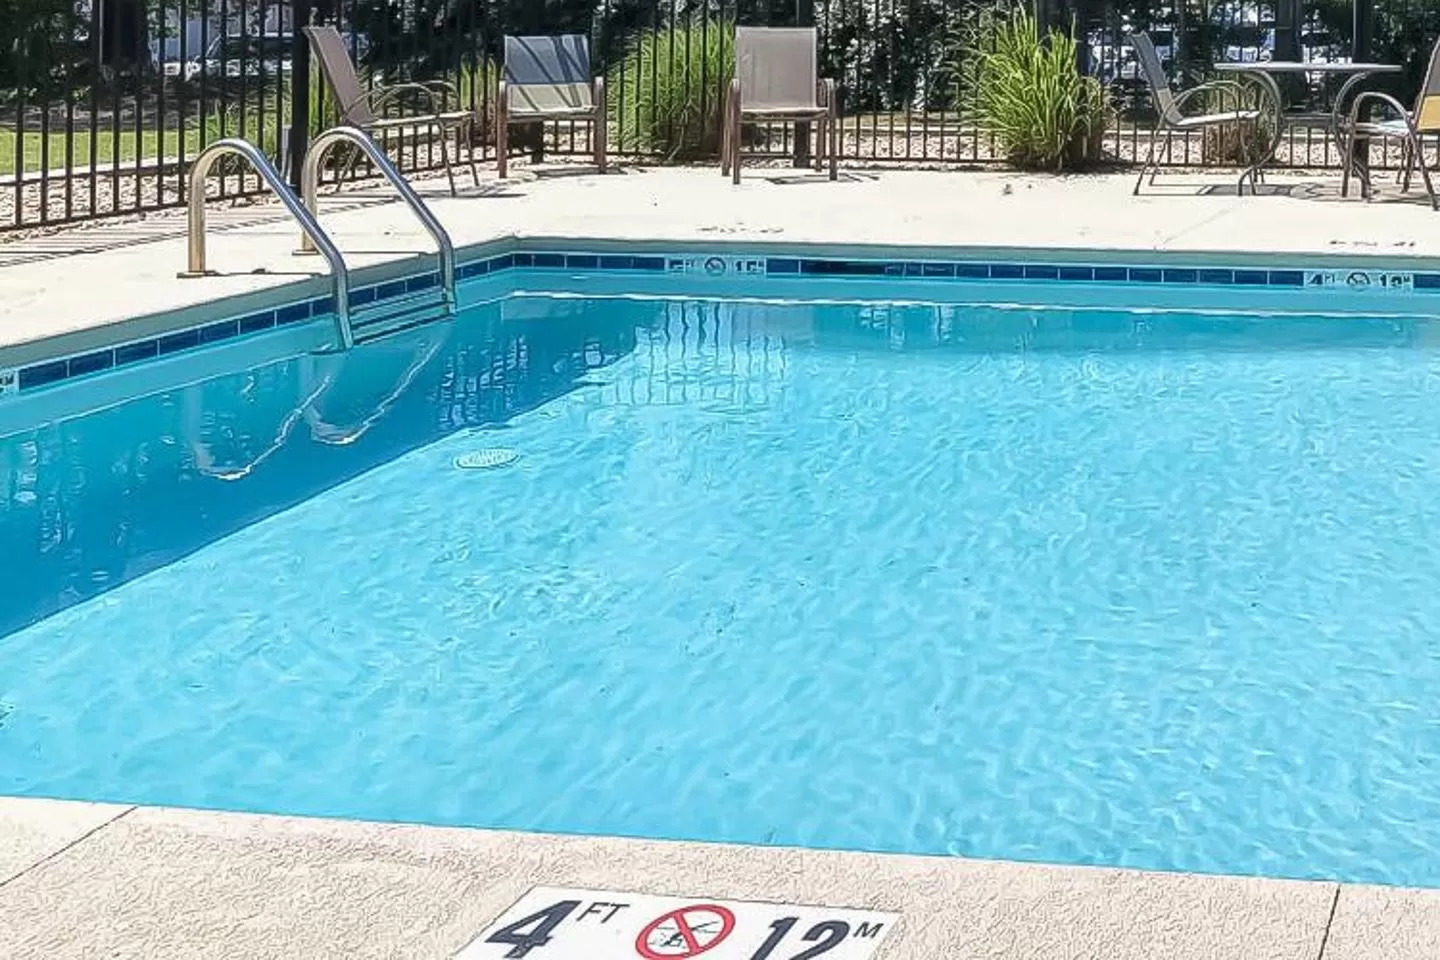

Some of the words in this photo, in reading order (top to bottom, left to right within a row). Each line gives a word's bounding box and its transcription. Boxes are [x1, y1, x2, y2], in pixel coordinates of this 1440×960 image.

[485, 900, 583, 958] 4
[576, 902, 630, 923] FT
[853, 921, 884, 939] M
